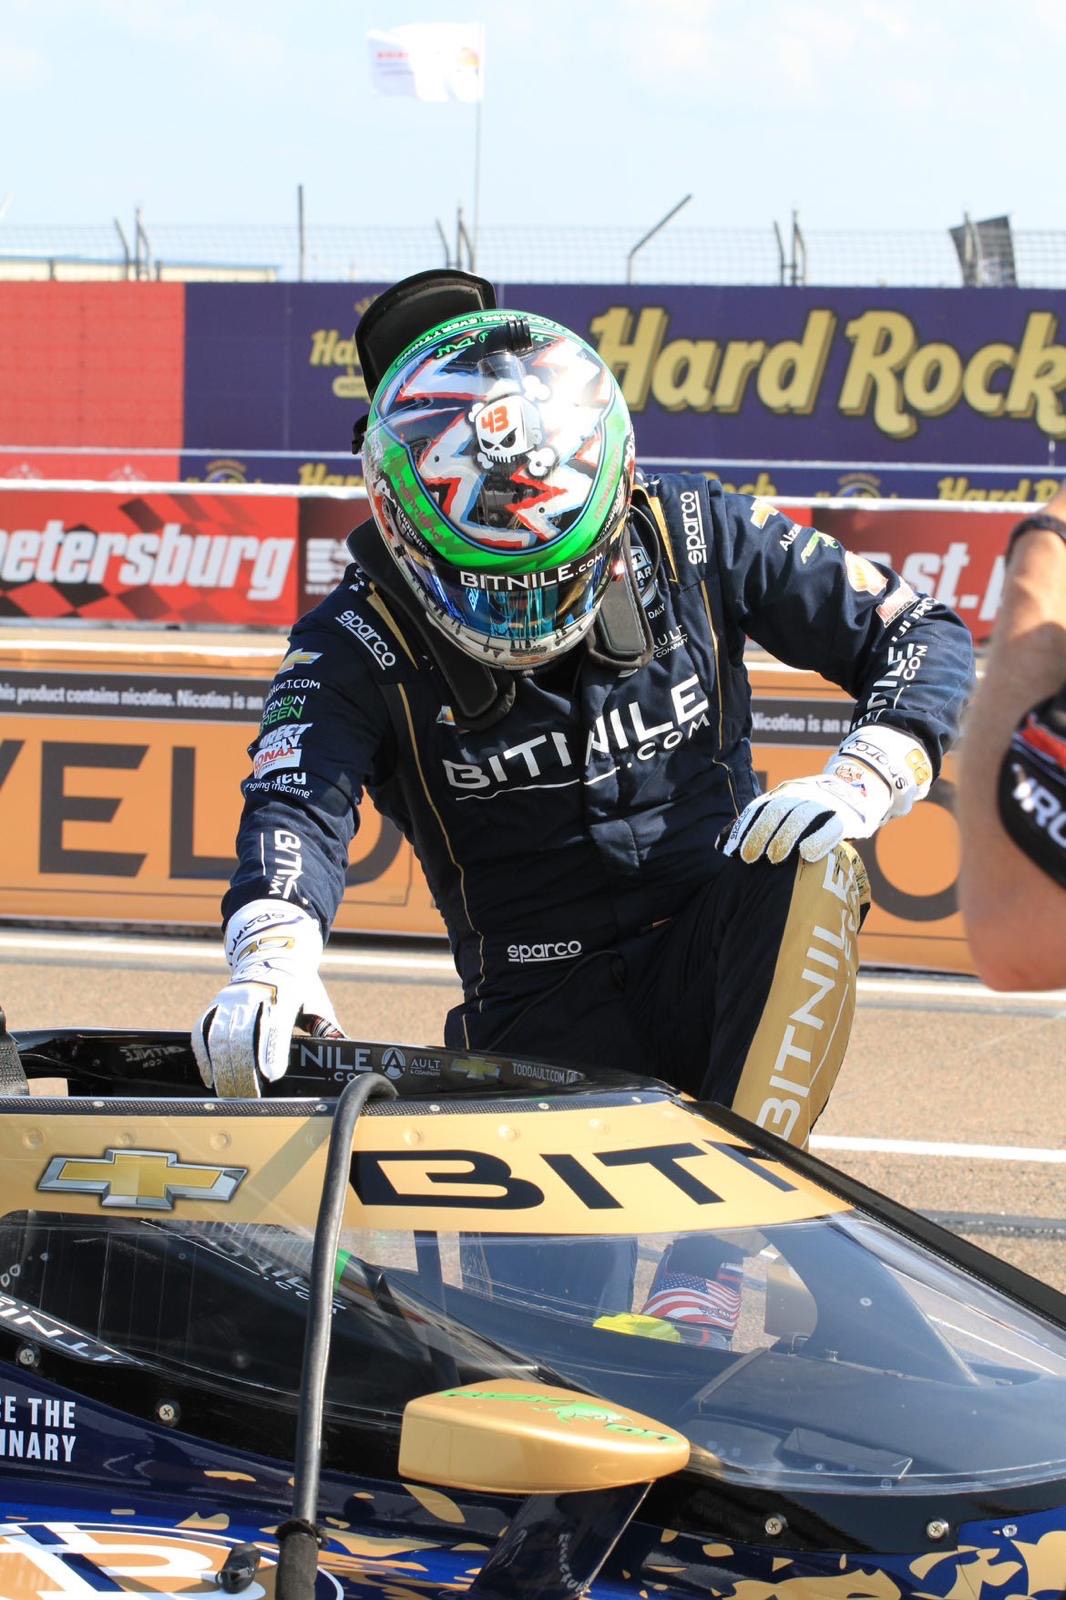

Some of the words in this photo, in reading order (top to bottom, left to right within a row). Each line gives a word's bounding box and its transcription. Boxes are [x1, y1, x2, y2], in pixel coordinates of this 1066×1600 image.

[591, 307, 836, 415] Hard
[839, 310, 1066, 438] Rock
[481, 406, 510, 433] 43
[680, 490, 707, 565] sparco
[0, 520, 294, 600] etersburg
[647, 603, 665, 620] DALY
[335, 610, 396, 670] sparco
[17, 684, 64, 706] product
[66, 687, 119, 704] contains
[177, 689, 231, 709] Nicotine
[232, 692, 245, 709] is
[247, 695, 262, 710] an
[261, 706, 303, 726] REEN
[807, 714, 820, 732] is
[823, 719, 839, 734] an
[507, 940, 582, 963] sparco
[756, 852, 850, 1142] BITNILE
[410, 1058, 441, 1069] AULT
[27, 1397, 76, 1429] THE
